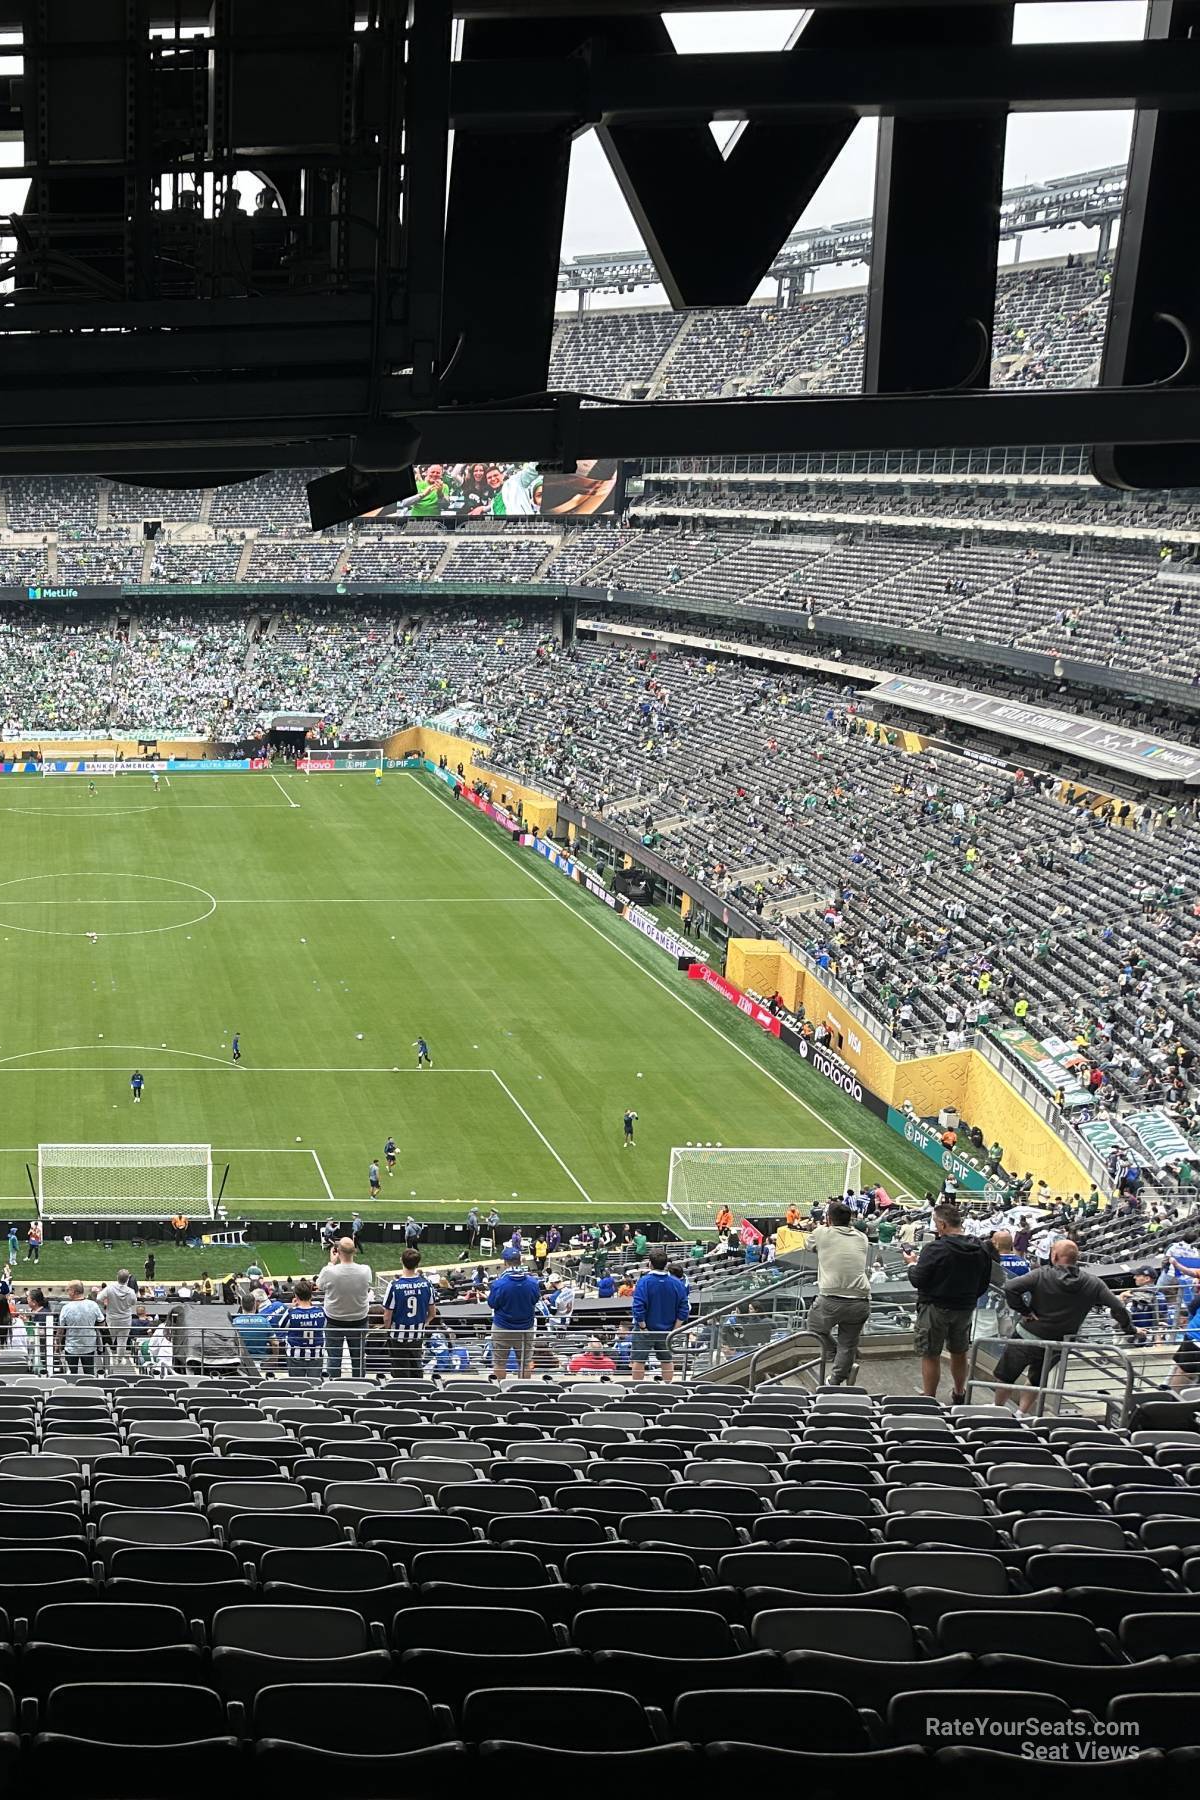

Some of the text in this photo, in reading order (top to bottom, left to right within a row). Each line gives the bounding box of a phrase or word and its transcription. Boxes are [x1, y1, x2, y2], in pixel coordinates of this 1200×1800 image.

[43, 588, 78, 598] MetLife
[34, 762, 57, 771] VISA
[396, 760, 409, 768] PIF
[628, 910, 646, 931] BANK
[646, 924, 656, 939] OF
[700, 964, 734, 1001] Budweiser
[848, 1027, 862, 1056] VISA
[813, 1053, 863, 1103] motorola
[913, 1129, 929, 1150] PIF
[952, 1159, 970, 1180] PIF
[414, 1281, 428, 1289] BOCK
[407, 1296, 418, 1318] 9
